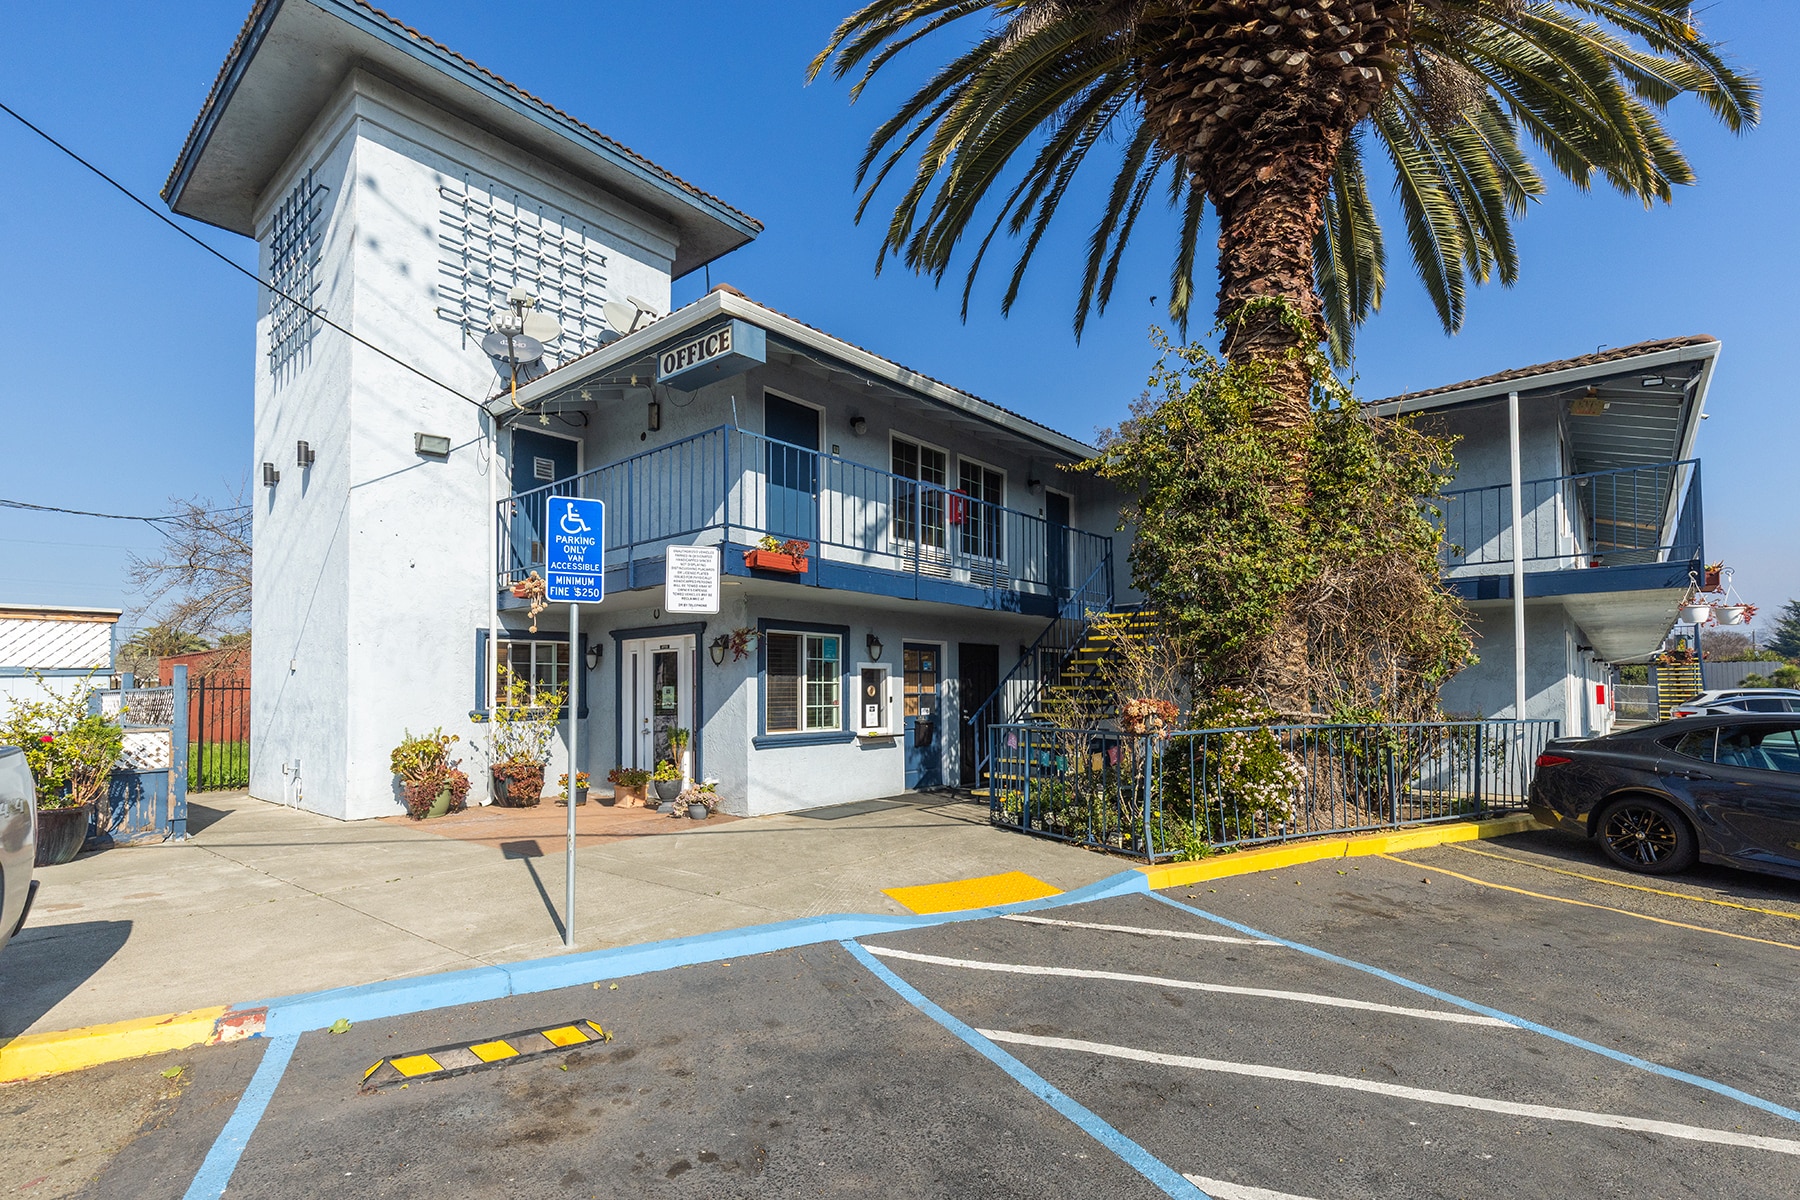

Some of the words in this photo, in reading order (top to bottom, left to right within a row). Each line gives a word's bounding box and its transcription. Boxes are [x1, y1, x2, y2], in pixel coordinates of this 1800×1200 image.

[664, 329, 730, 374] OFFICE
[556, 535, 595, 545] PARKING
[564, 545, 587, 554] ONLY
[551, 562, 599, 571] ACCESSIBLE
[556, 576, 594, 586] MINIMUM
[550, 587, 569, 596] FINE
[575, 588, 599, 597] $250
